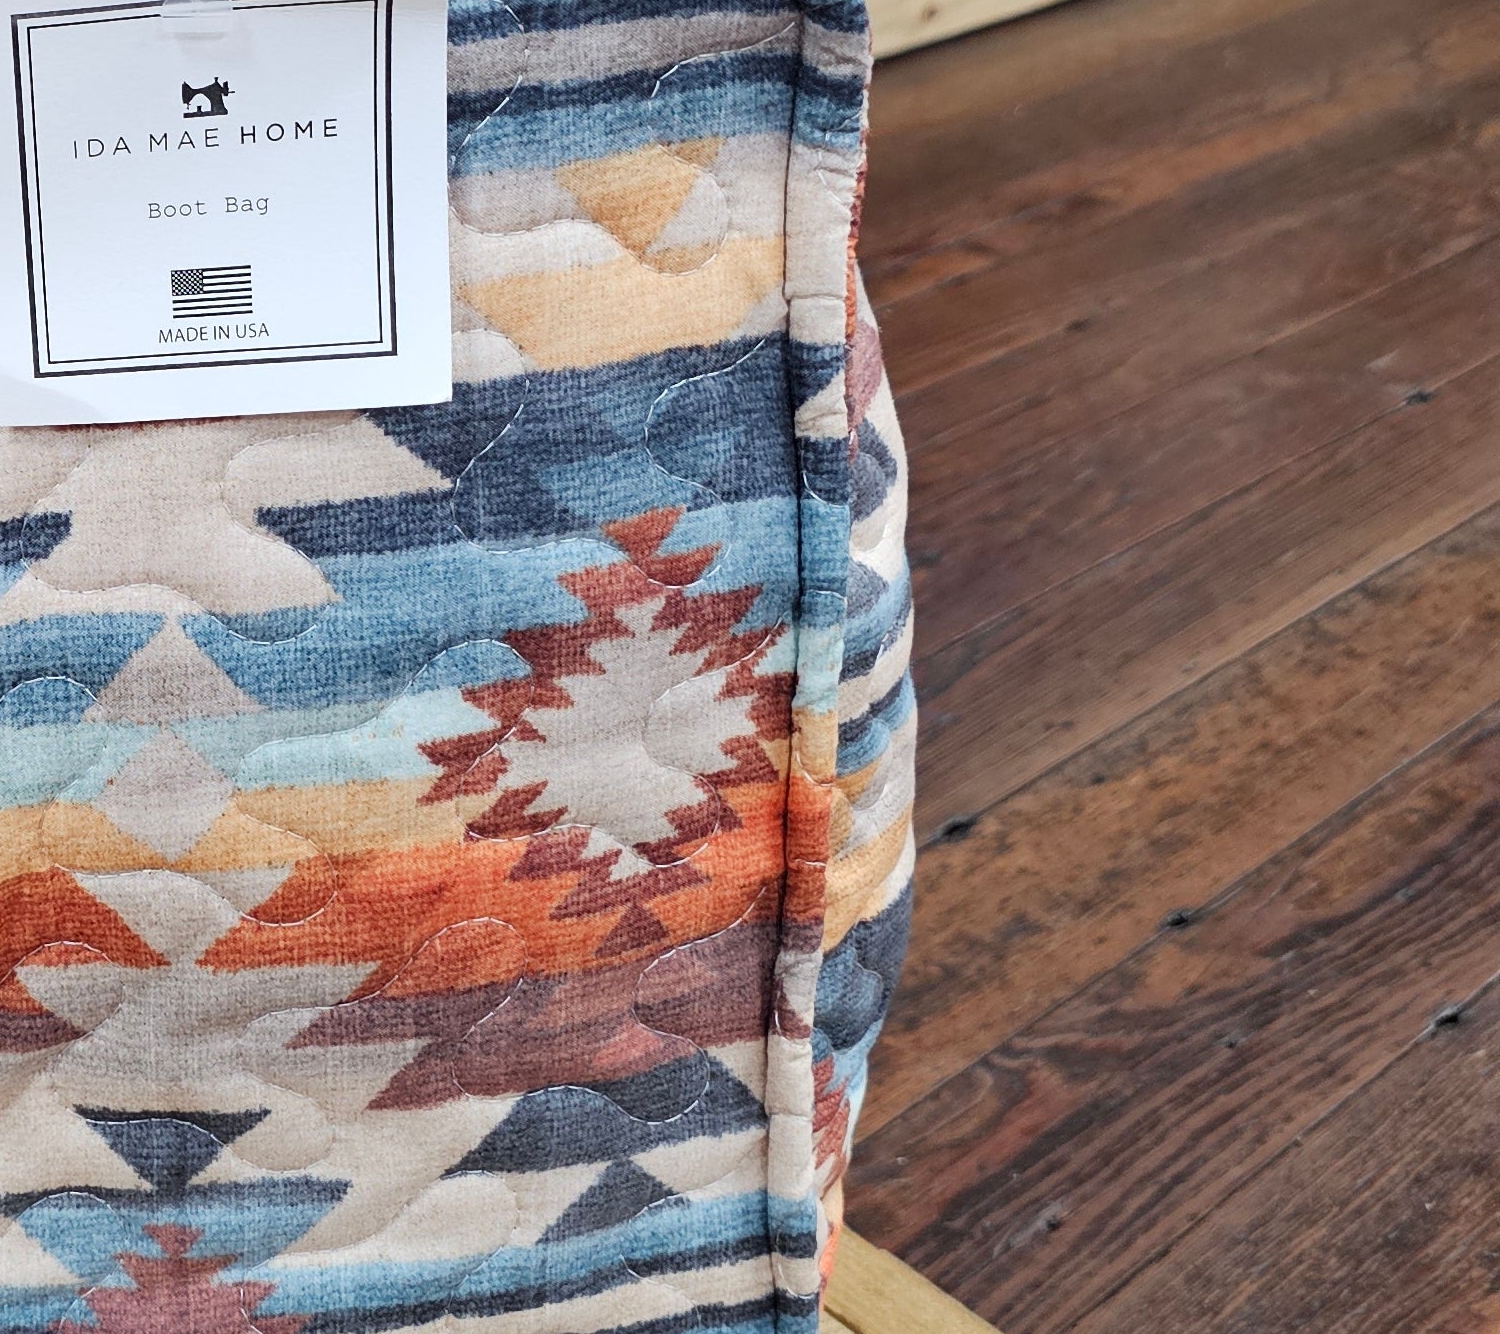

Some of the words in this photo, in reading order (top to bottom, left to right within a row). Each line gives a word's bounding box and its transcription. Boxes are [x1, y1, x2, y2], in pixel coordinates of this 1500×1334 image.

[73, 136, 132, 159] IDA
[149, 127, 220, 153] MAE
[240, 118, 338, 145] HOME
[147, 199, 208, 219] Boot
[224, 196, 270, 215] Bag
[158, 325, 209, 344] MADE
[212, 324, 230, 341] IN
[235, 322, 270, 339] USA
